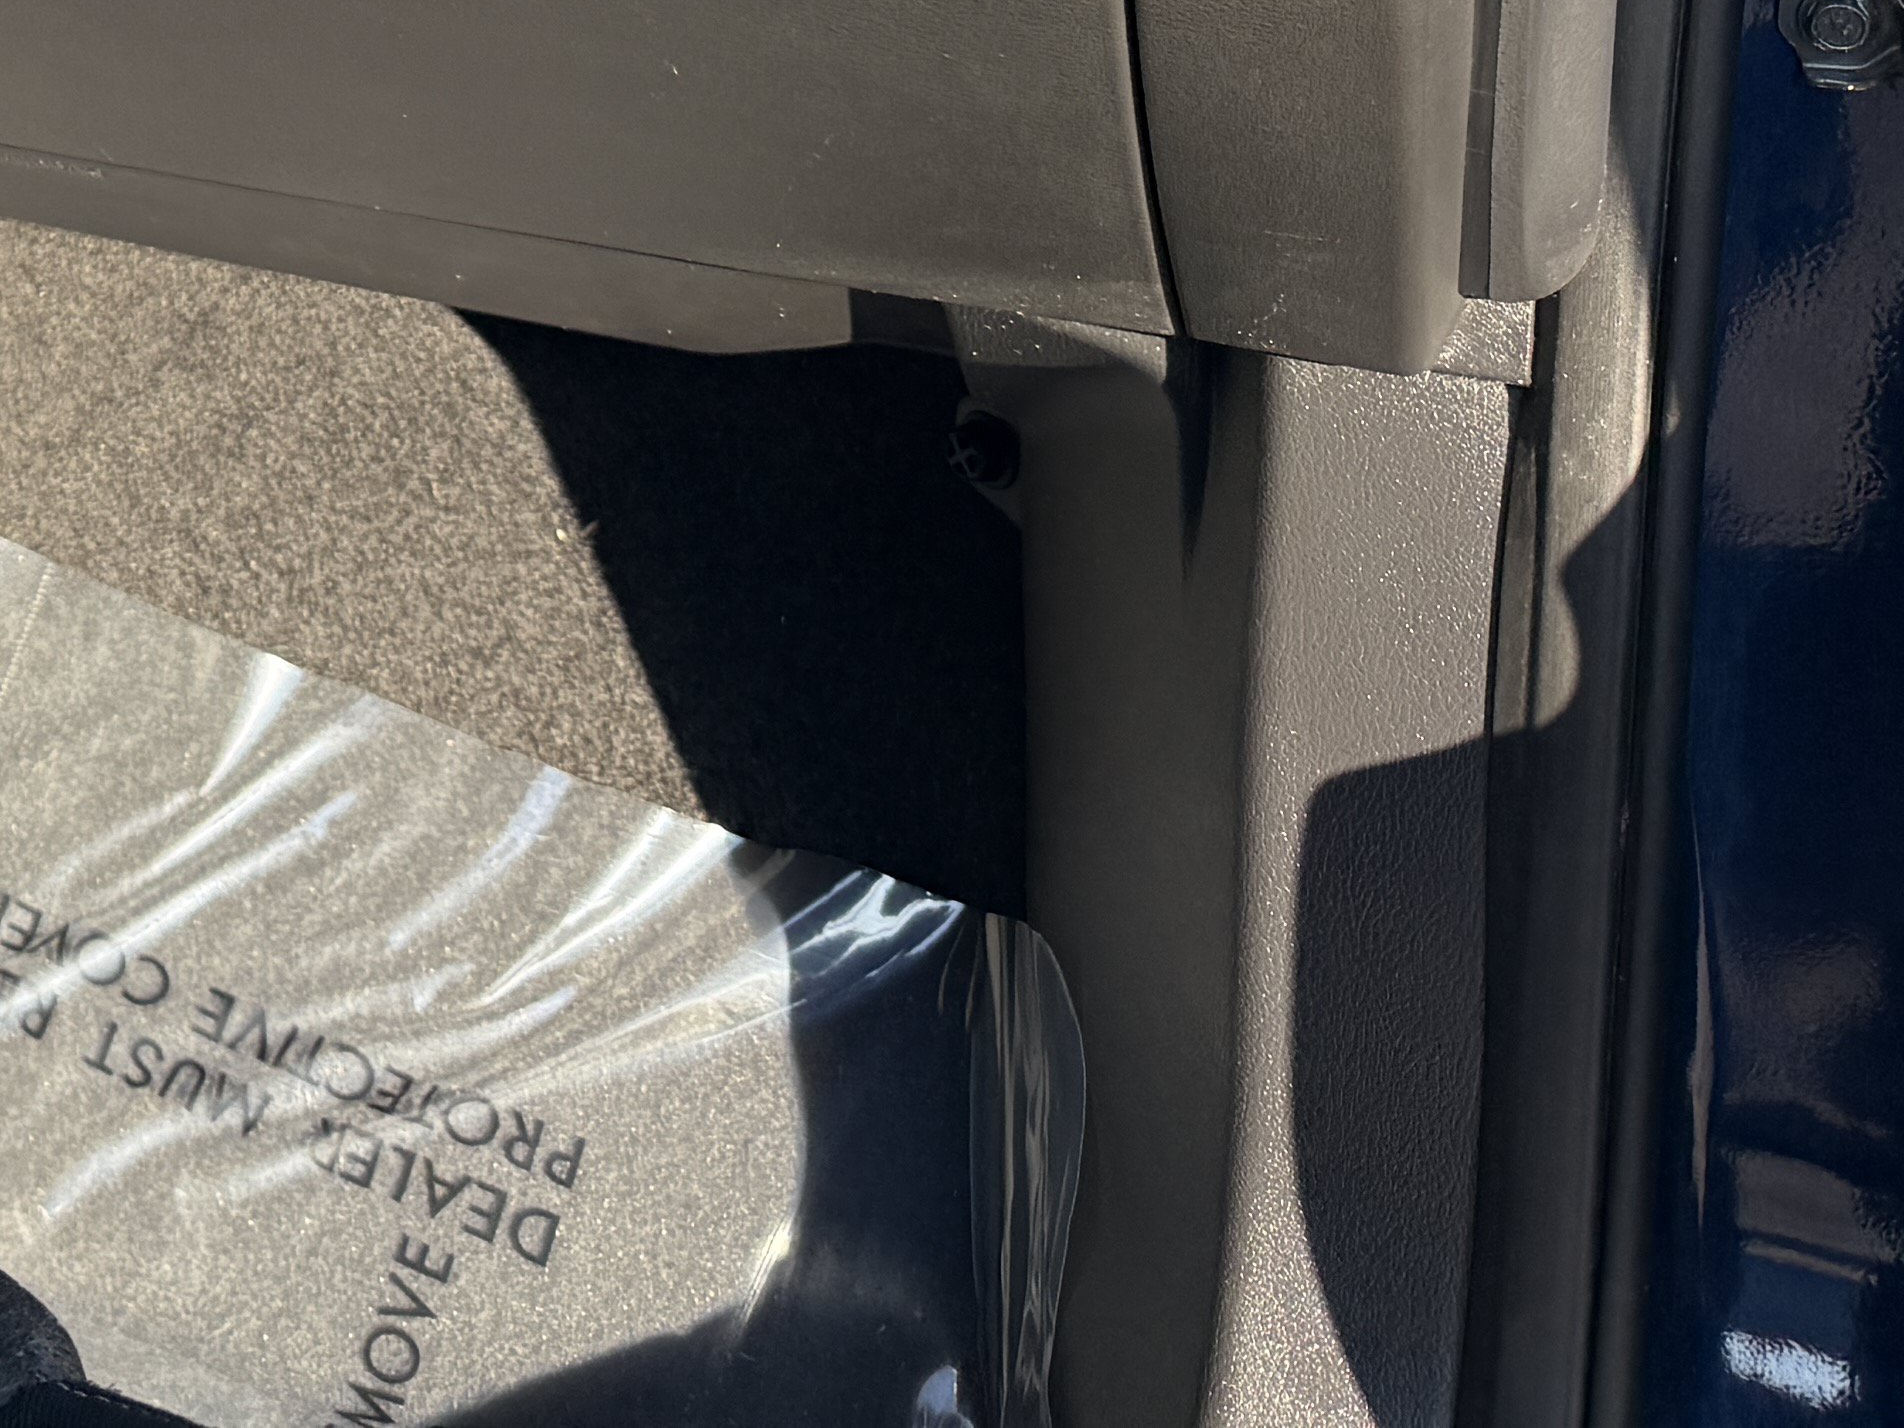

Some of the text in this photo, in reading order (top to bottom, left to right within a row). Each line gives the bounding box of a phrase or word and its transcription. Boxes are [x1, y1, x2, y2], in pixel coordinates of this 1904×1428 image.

[82, 1020, 273, 1138] MUST
[192, 986, 587, 1190] PROTECTIVE
[309, 1117, 562, 1268] DEALER
[323, 1233, 456, 1428] MOVE
